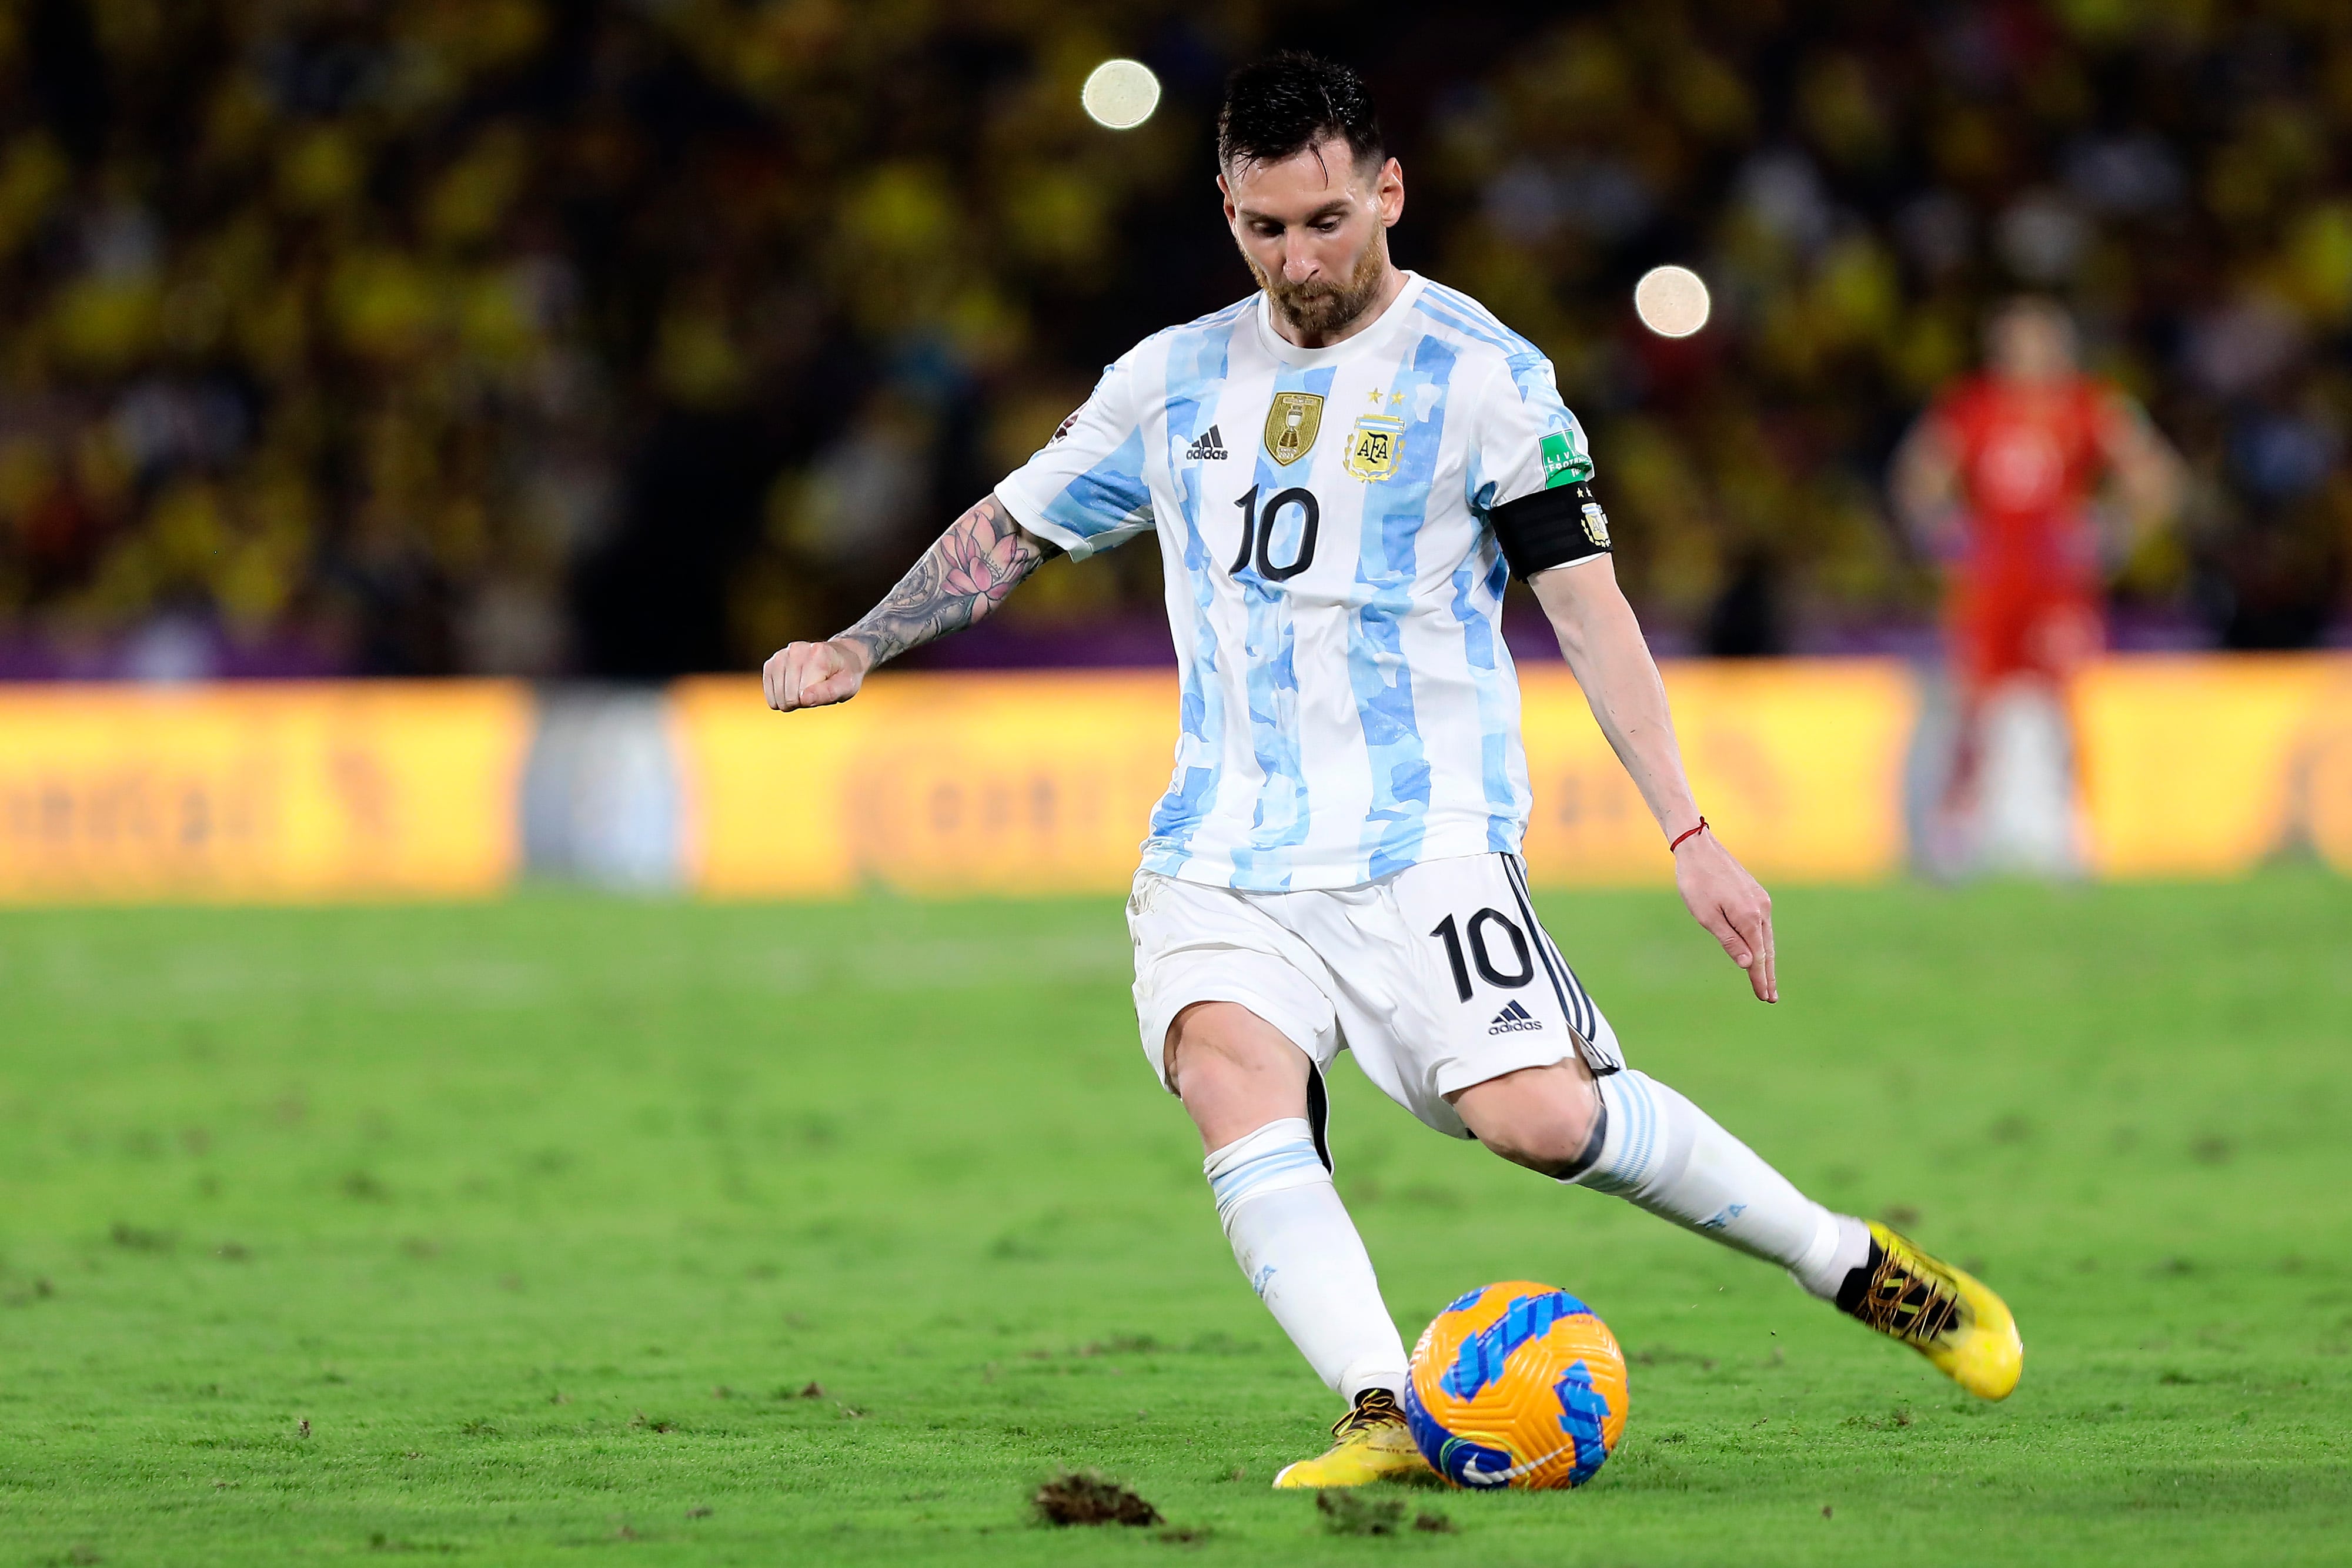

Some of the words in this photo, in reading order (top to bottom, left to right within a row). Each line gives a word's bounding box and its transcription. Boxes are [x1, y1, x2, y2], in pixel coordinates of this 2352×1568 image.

[1186, 447, 1228, 460] adidas
[1357, 432, 1388, 463] AFA
[1548, 457, 1592, 472] FOOTBA
[1228, 483, 1319, 582] 10
[1429, 907, 1534, 1004] 10
[1489, 1021, 1543, 1035] adidas
